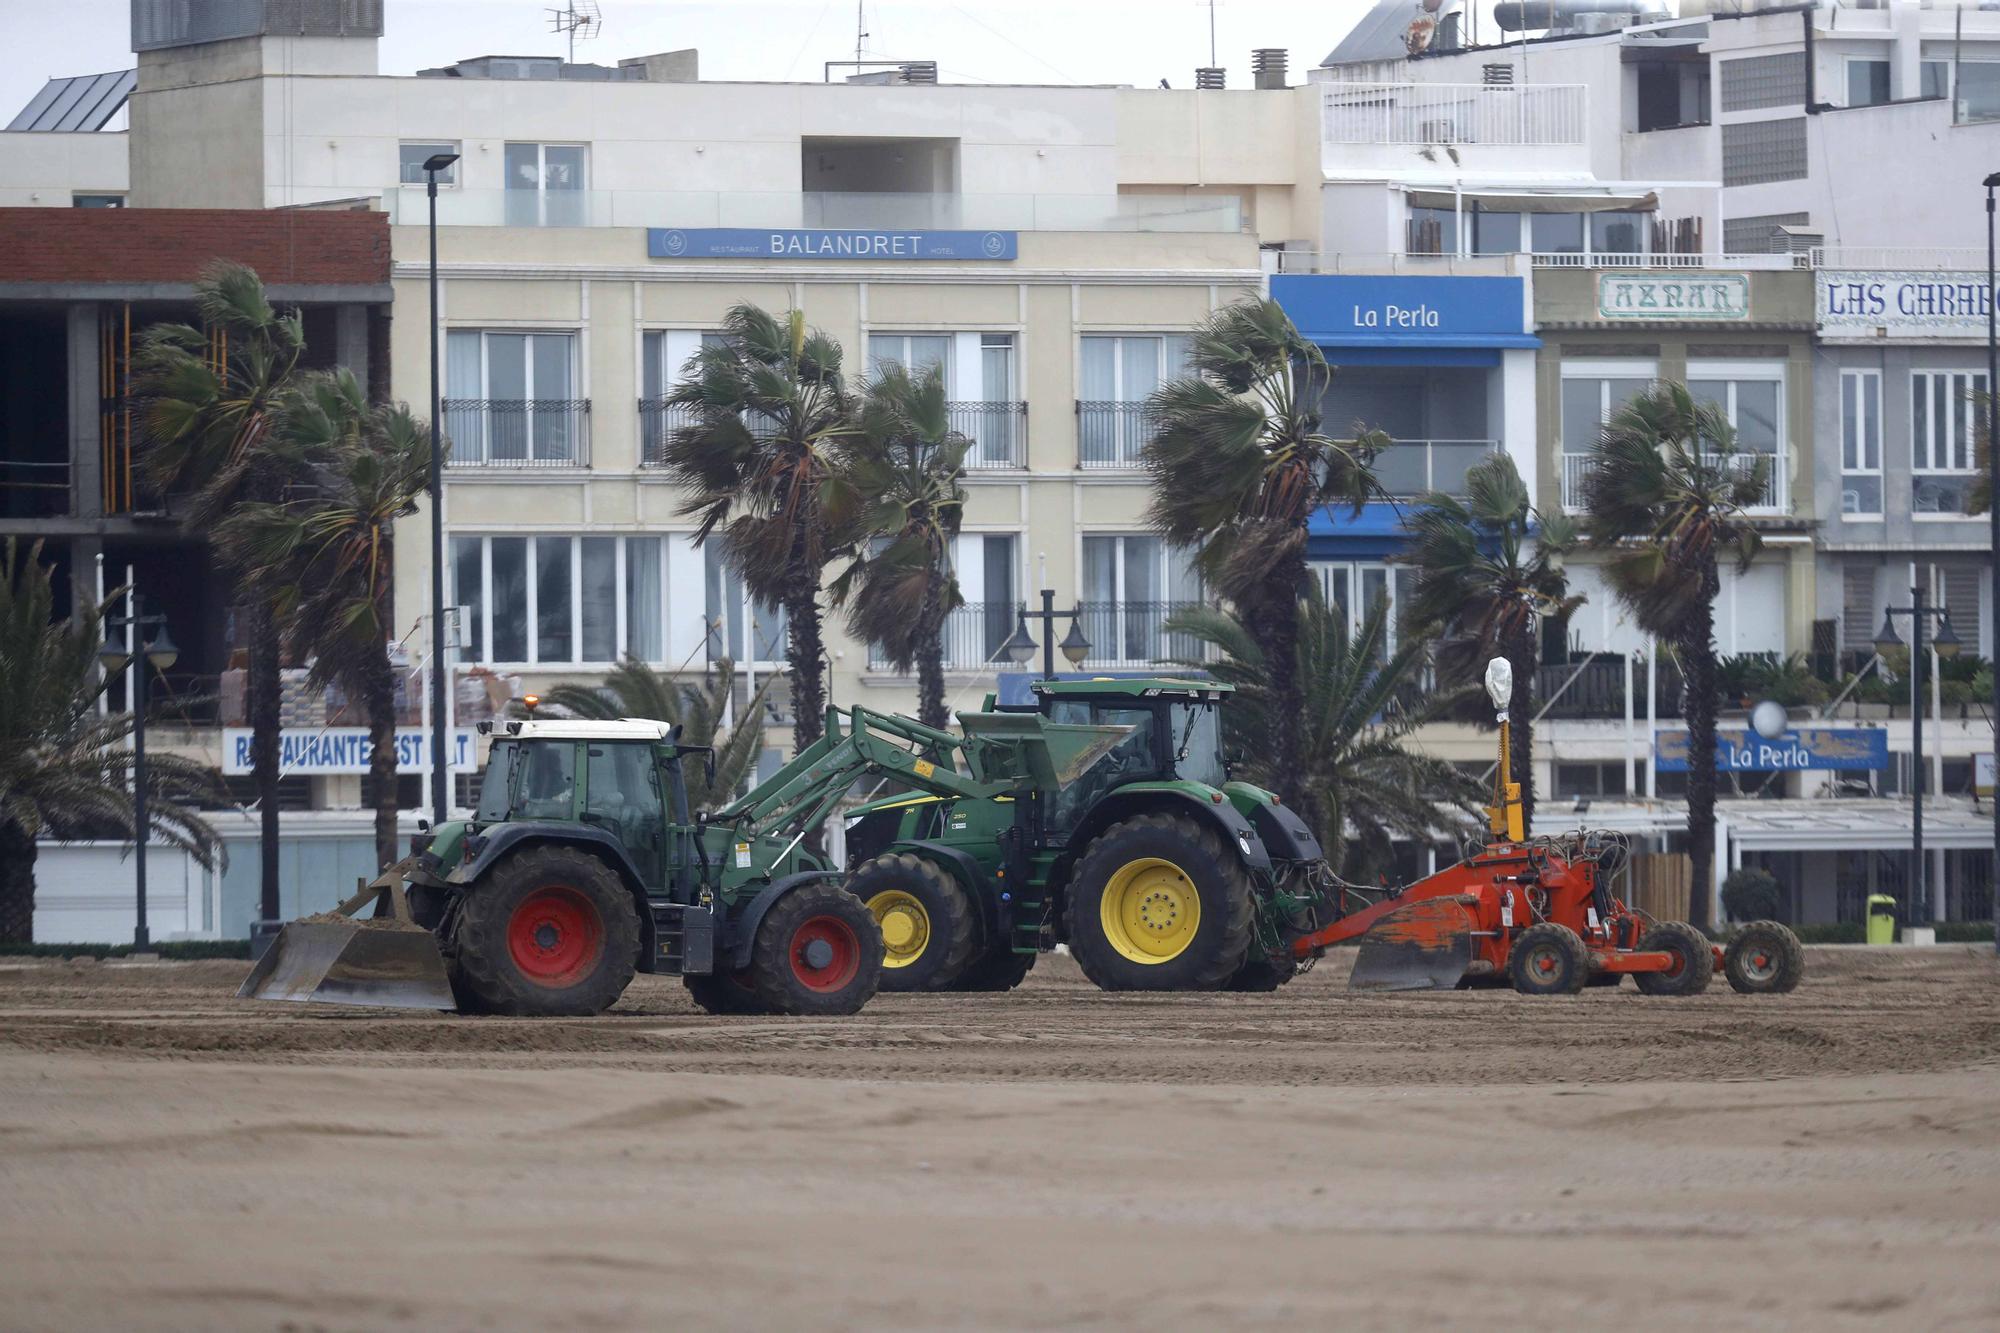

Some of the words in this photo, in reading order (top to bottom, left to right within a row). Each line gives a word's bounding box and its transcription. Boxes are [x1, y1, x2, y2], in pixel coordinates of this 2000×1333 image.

[770, 234, 922, 254] BALANDRET
[930, 247, 953, 255] HOTEL
[1828, 283, 1886, 316] LAS
[1354, 304, 1377, 327] La
[1386, 304, 1439, 327] Perla
[1730, 746, 1752, 768] La
[1759, 745, 1809, 768] Perla
